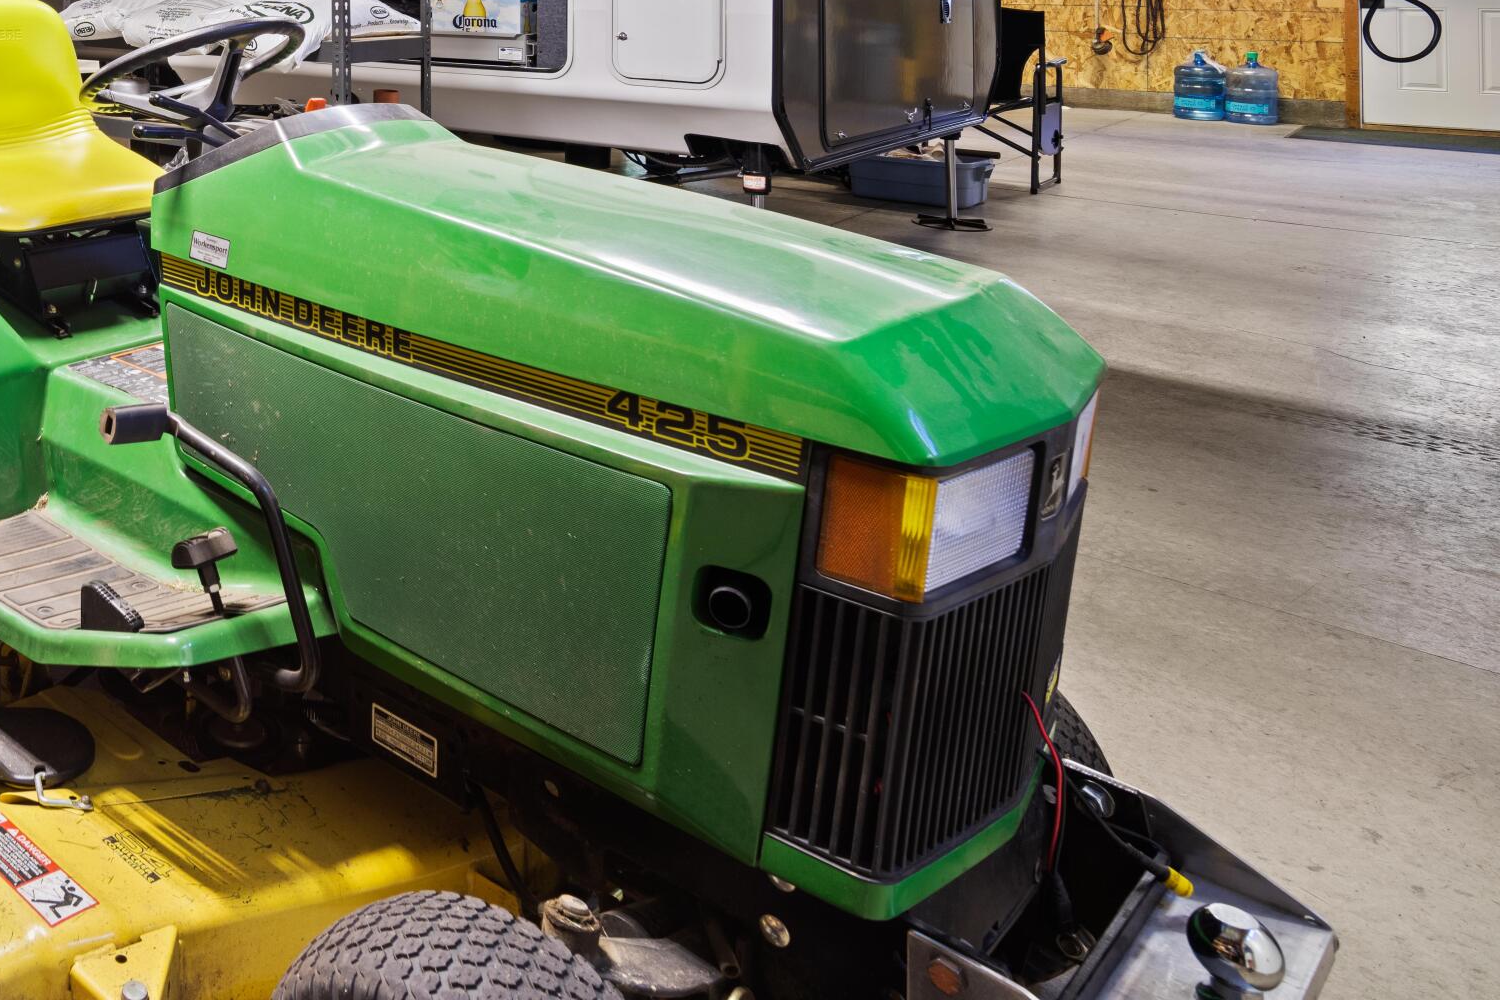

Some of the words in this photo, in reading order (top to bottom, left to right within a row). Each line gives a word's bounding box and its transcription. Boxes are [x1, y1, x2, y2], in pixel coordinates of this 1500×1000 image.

[453, 14, 497, 28] Corona
[195, 267, 282, 320] JOHN
[292, 295, 414, 363] DEERE
[605, 390, 750, 460] 425
[16, 834, 52, 866] DANGER
[115, 829, 172, 878] 54
